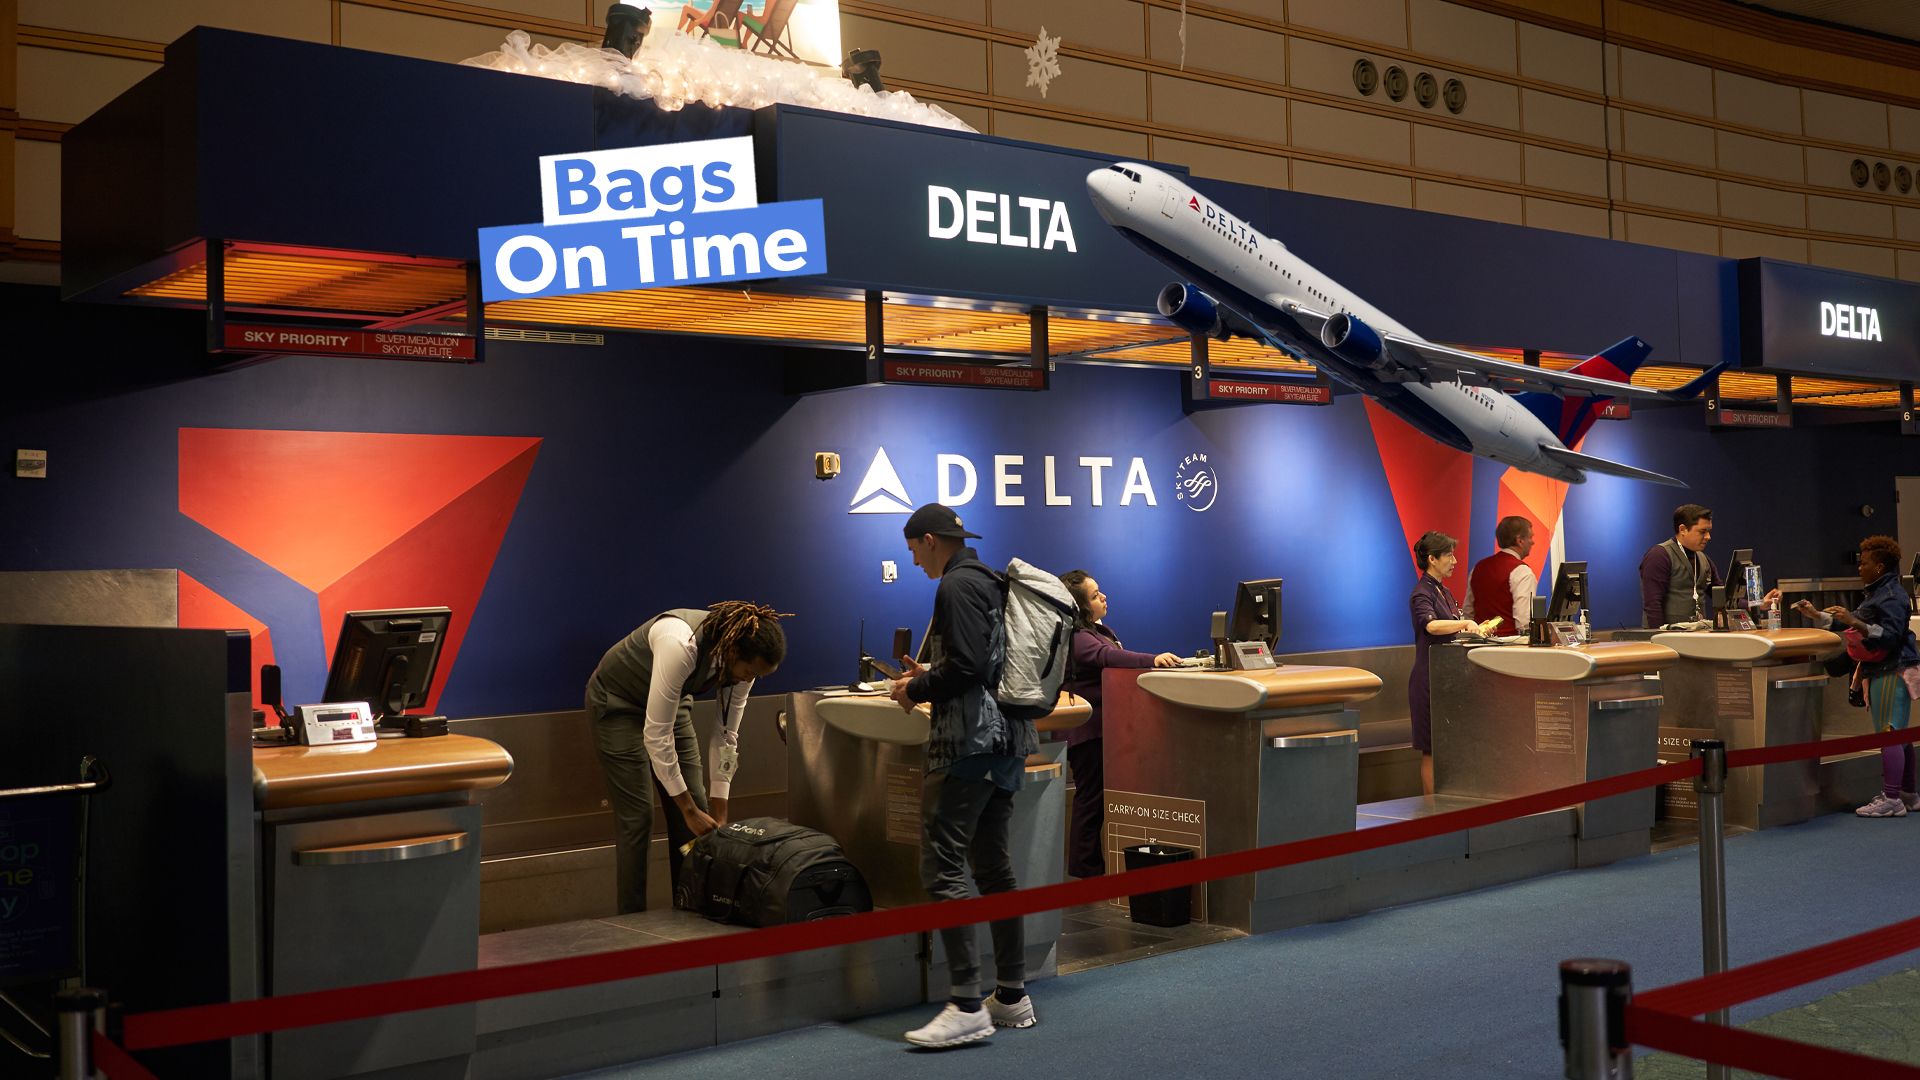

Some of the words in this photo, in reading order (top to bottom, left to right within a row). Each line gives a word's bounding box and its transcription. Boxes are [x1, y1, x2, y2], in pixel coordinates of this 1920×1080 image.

[928, 184, 1077, 253] DELTA
[1206, 204, 1259, 249] DELTA
[1820, 301, 1883, 342] DELTA
[244, 331, 273, 343] SKY
[280, 332, 349, 347] PRIORITY
[375, 333, 406, 345] SILVER
[408, 335, 459, 347] MEDALLION
[382, 345, 427, 356] SKYTEAM
[429, 346, 452, 357] ELITE
[869, 345, 876, 359] 2
[896, 367, 915, 376] SKY
[919, 368, 963, 379] PRIORITY
[979, 367, 999, 377] SILVER
[1000, 369, 1033, 378] MEDALLION
[1195, 365, 1202, 378] 3
[984, 377, 1013, 385] SKYTEAM
[1218, 385, 1234, 393] SKY
[1235, 386, 1269, 395] PRIORITY
[1708, 400, 1715, 410] 5
[1732, 413, 1747, 424] SKY
[1749, 414, 1779, 425] PRIORITY
[1903, 411, 1911, 421] 6
[936, 453, 1158, 507] DELTA
[1175, 453, 1207, 501] SKYTEAM
[1663, 737, 1680, 746] SIZE
[1108, 803, 1150, 818] CARRY-ON
[1152, 808, 1169, 819] SIZE
[1172, 811, 1200, 823] CHECK
